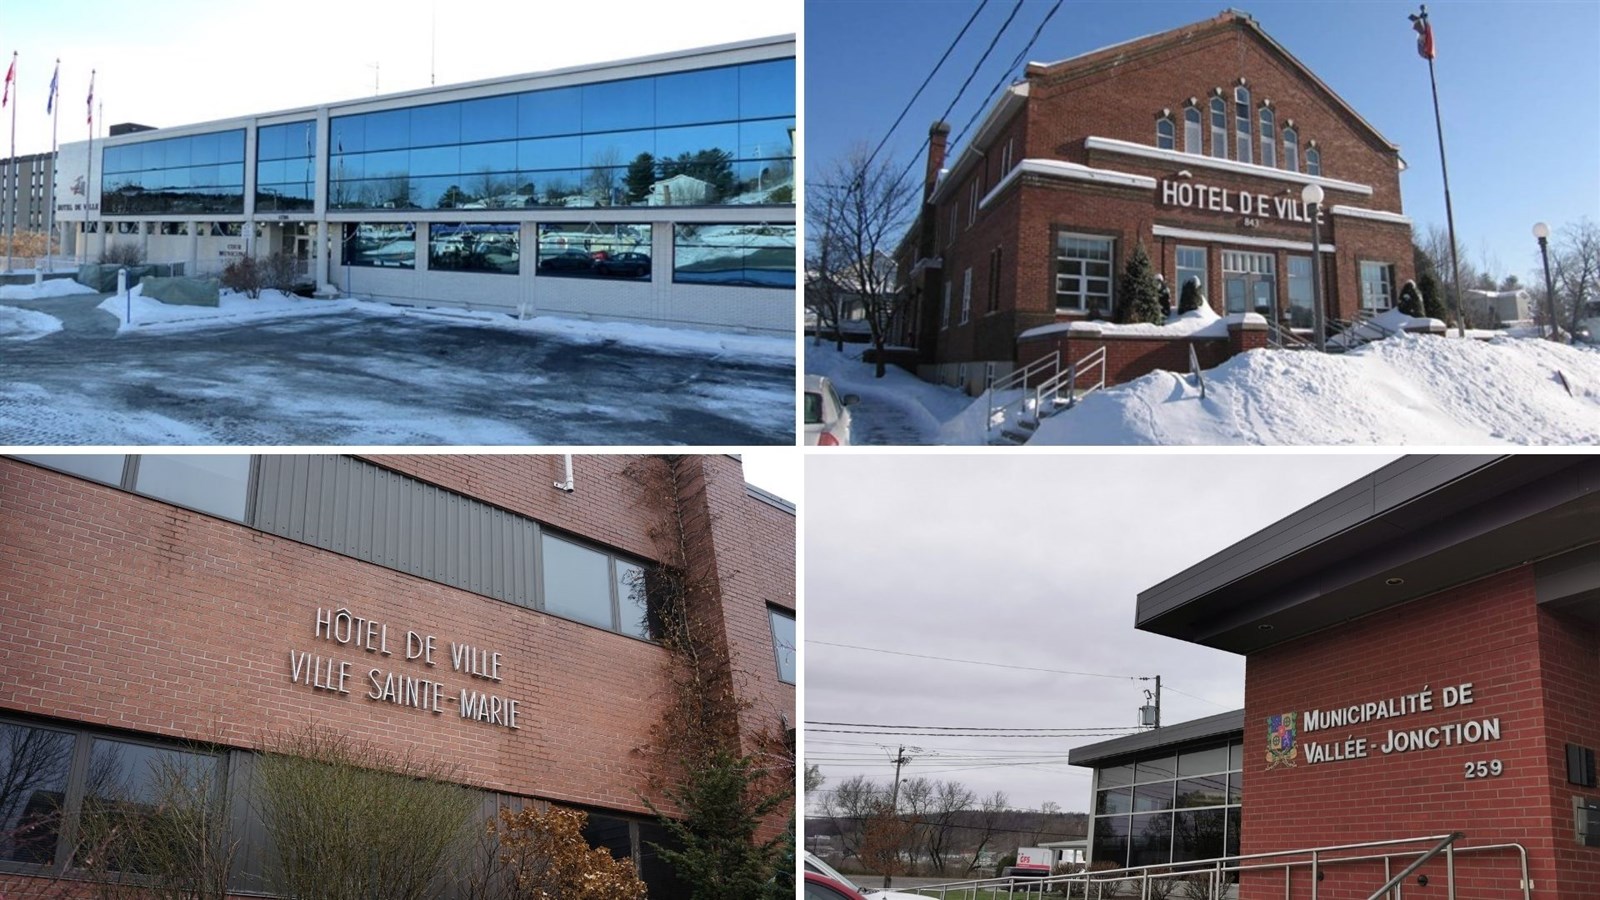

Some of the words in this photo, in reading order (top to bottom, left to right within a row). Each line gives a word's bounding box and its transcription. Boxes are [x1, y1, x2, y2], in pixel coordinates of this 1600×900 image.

[1162, 170, 1234, 212] HÔTEL
[1240, 191, 1269, 218] DE
[1244, 217, 1260, 228] 843
[315, 607, 392, 656] HÔTEL
[406, 631, 437, 666] DE
[451, 641, 503, 681] VILLE
[290, 649, 352, 694] VILLE
[1303, 685, 1433, 733] MUNICIPALITÉ
[1443, 682, 1474, 708] DE
[1464, 758, 1503, 779] 259
